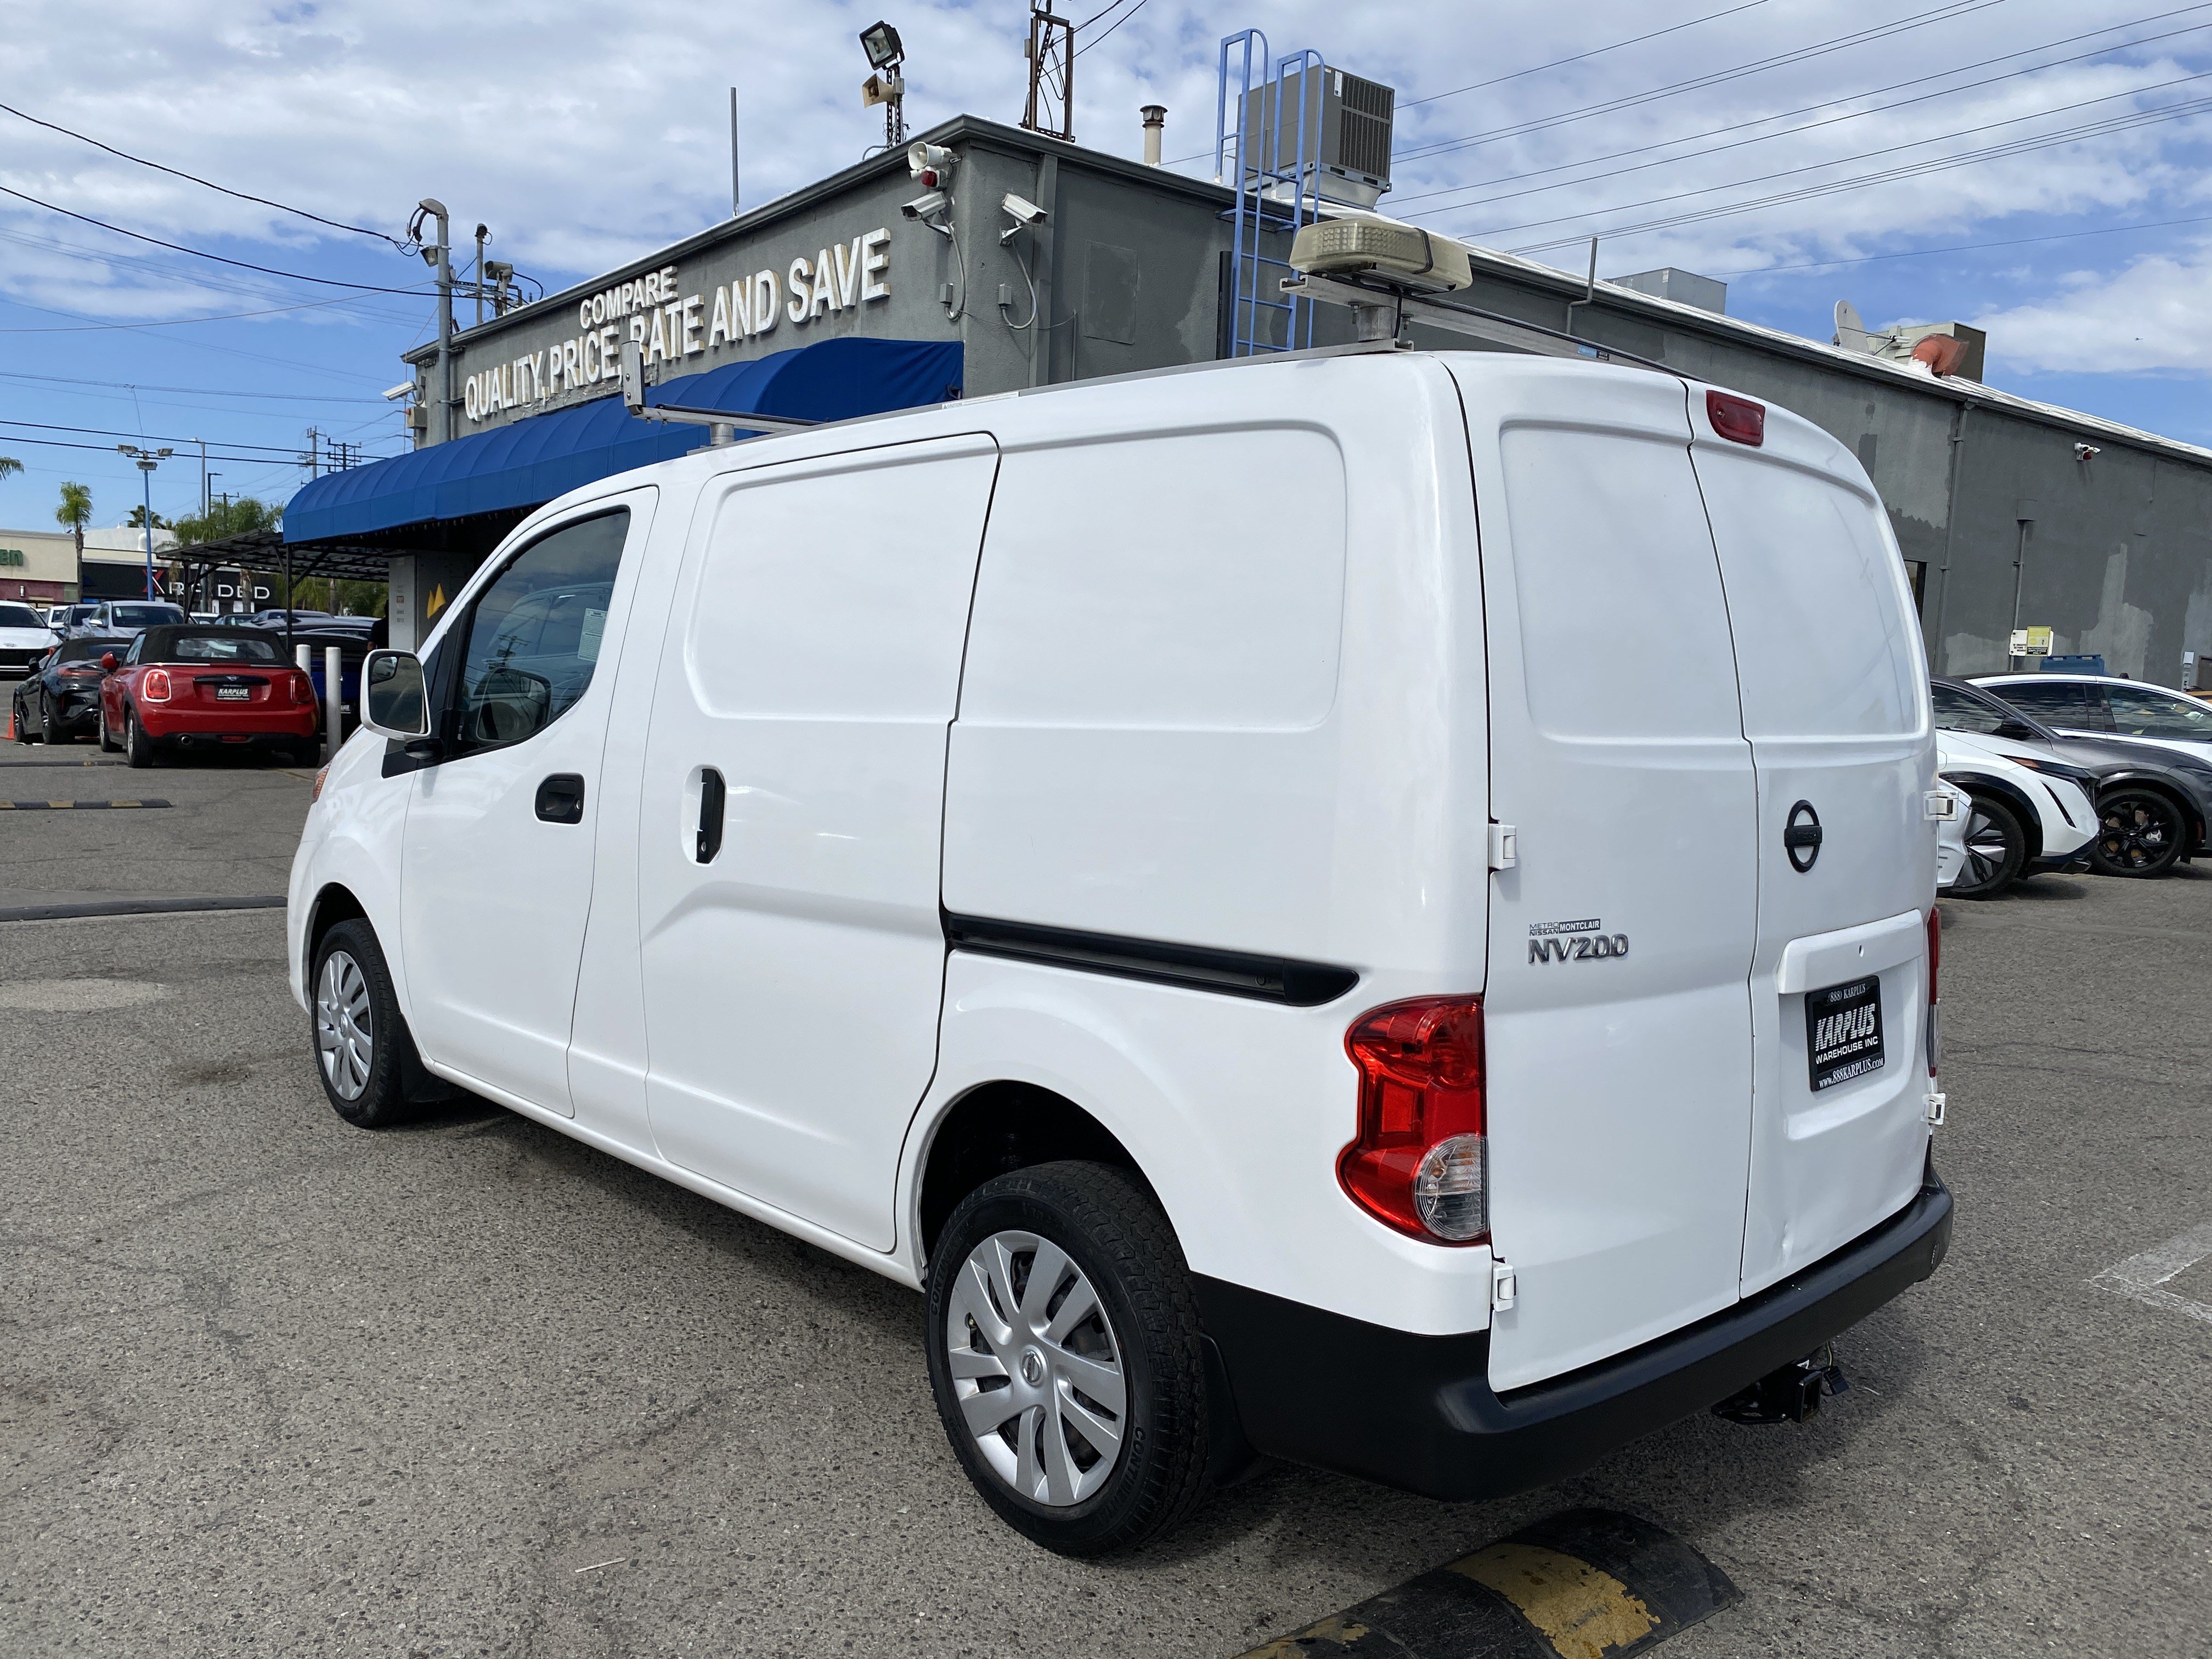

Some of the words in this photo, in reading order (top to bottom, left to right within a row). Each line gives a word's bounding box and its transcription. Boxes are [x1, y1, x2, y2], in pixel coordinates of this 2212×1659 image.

[579, 266, 679, 330] COMPARE
[629, 294, 705, 366] RATE
[709, 269, 782, 347] AND
[787, 227, 891, 324] SAVE
[1559, 920, 1600, 932] MONTCLAIR
[1528, 933, 1629, 964] NV200
[1828, 990, 1842, 1003] (888)
[1843, 983, 1866, 1000] KARPLUS
[1815, 1003, 1876, 1052] KARPLUS
[1815, 1040, 1864, 1065] WAREHOUSE
[1865, 1035, 1879, 1048] INC
